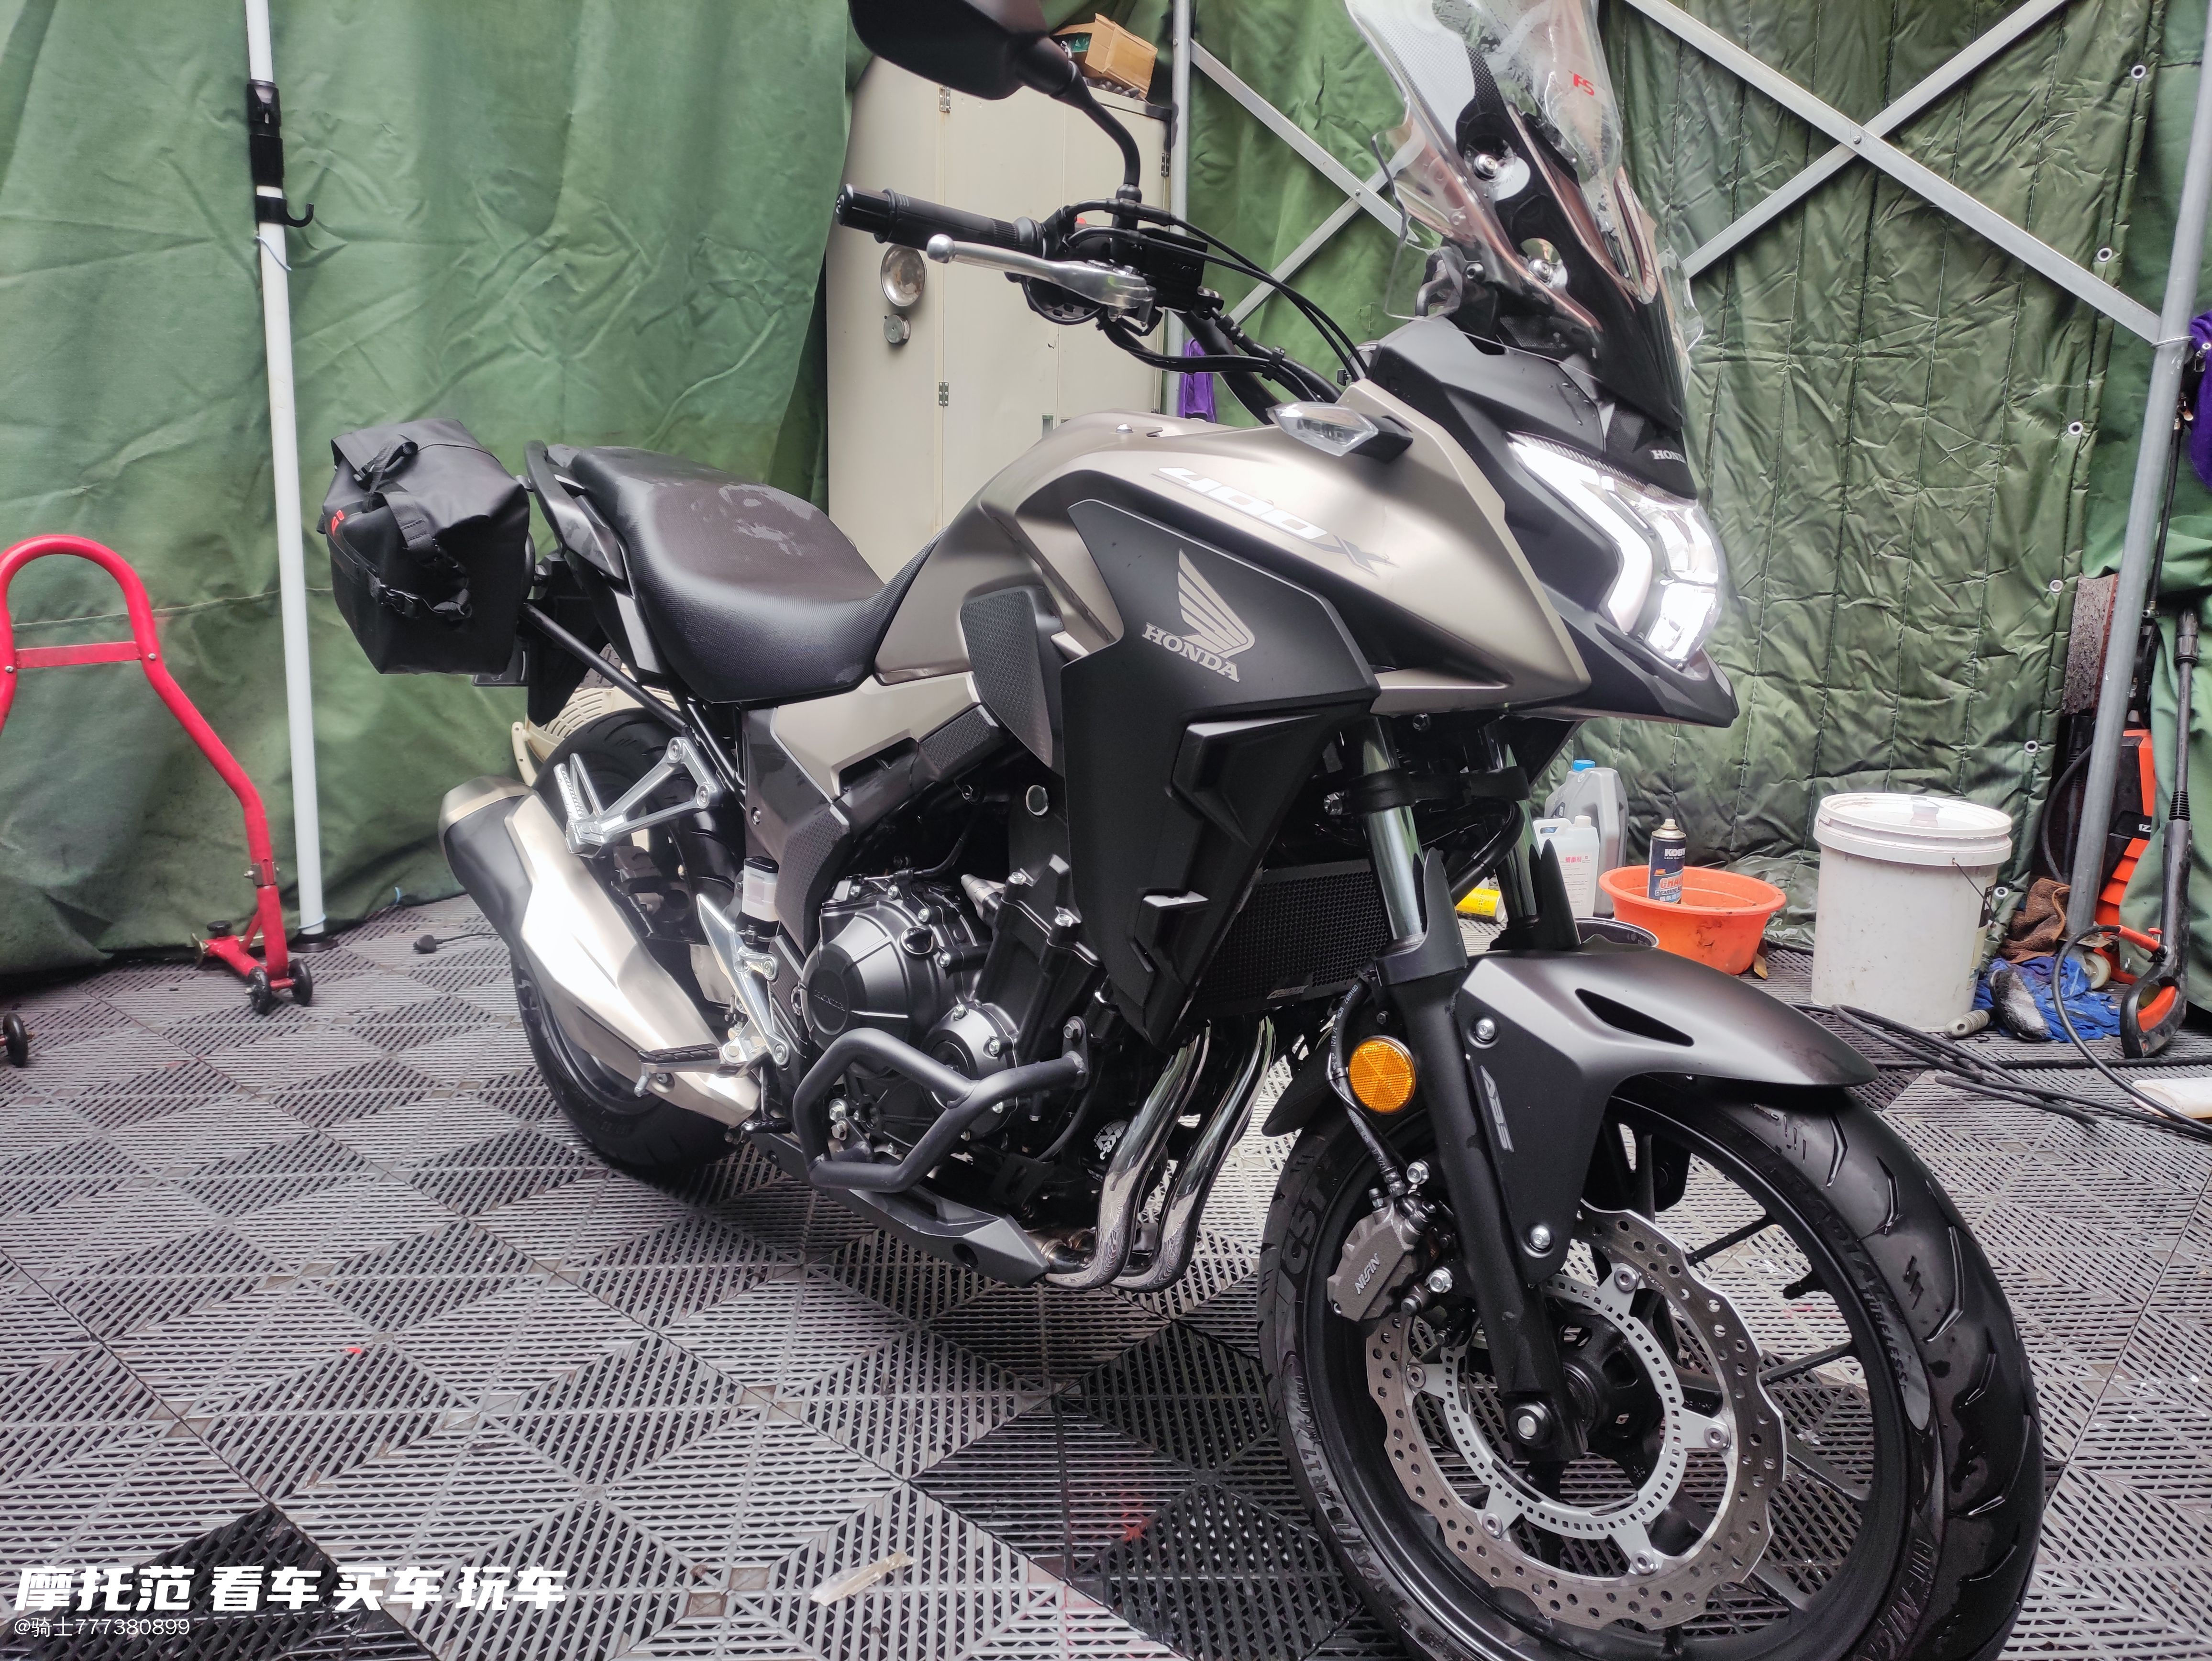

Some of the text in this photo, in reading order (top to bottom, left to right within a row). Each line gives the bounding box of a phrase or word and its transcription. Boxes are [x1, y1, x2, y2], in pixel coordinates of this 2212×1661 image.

[1651, 450, 1687, 465] HOND
[1142, 622, 1240, 683] HONDA
[1480, 1065, 1514, 1152] ABS
